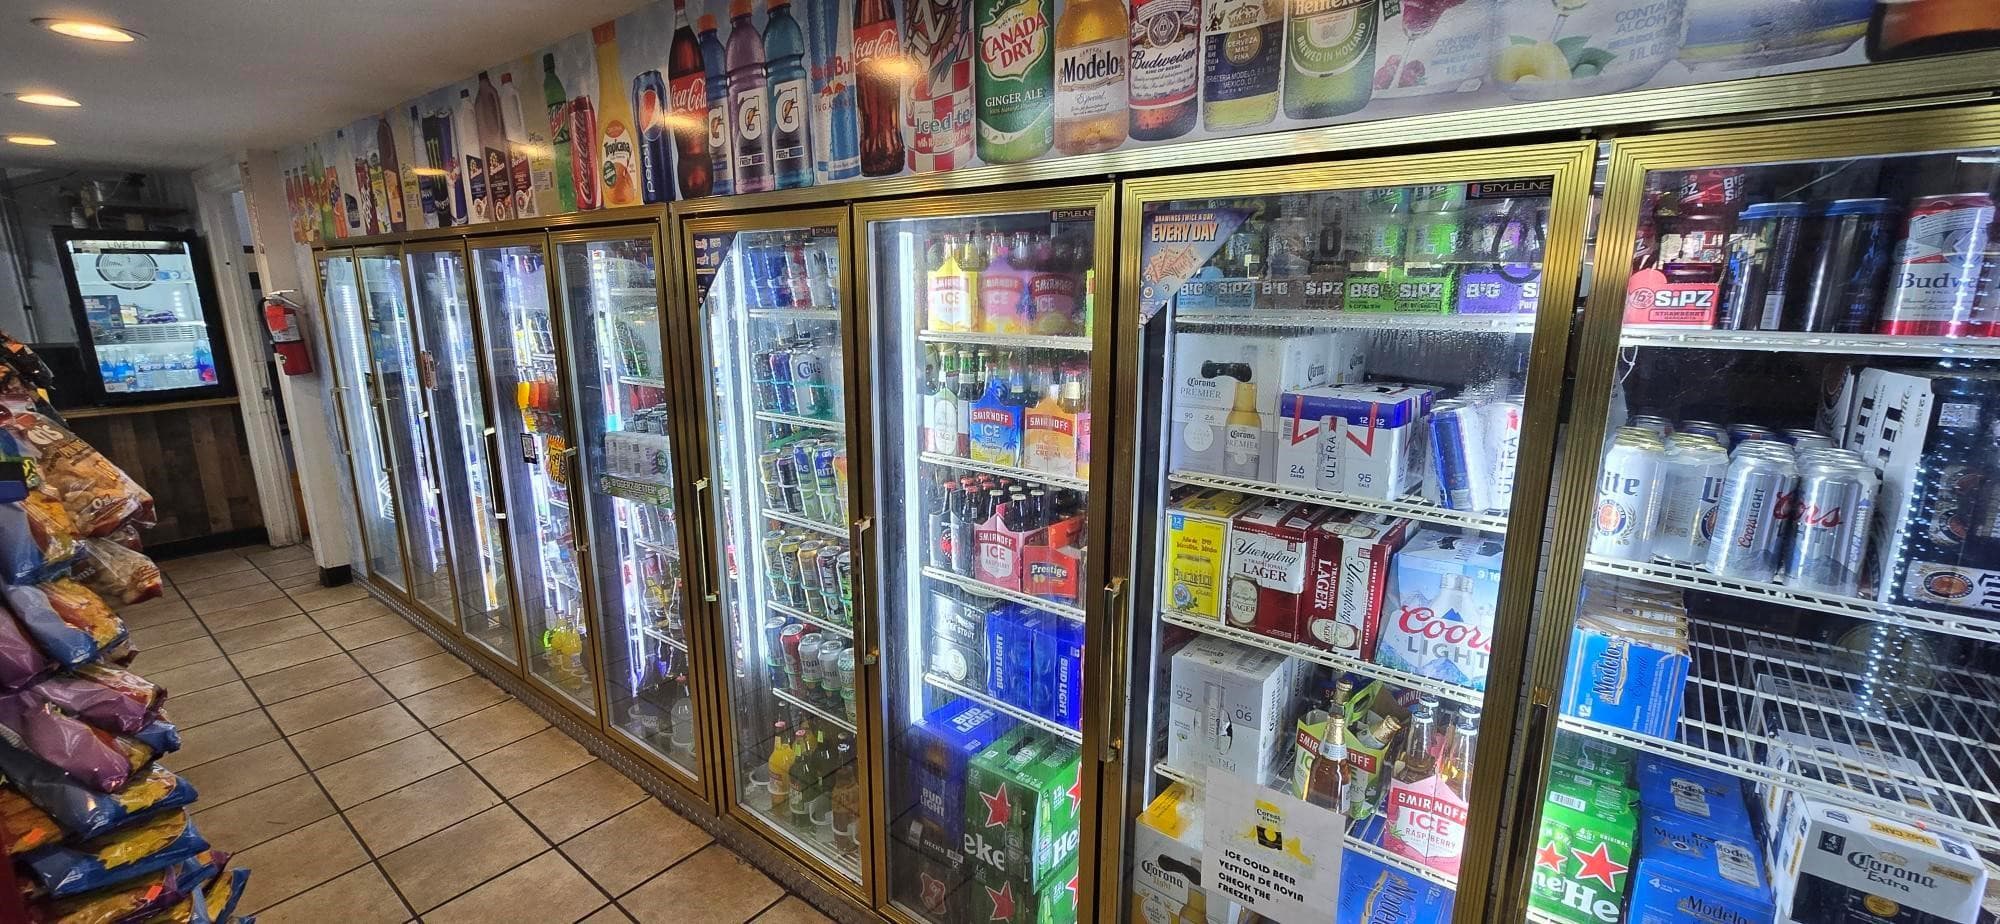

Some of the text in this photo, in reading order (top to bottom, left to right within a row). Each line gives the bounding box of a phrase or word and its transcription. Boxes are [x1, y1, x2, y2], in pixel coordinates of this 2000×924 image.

[980, 11, 1049, 64] CANADA
[1297, 21, 1367, 62] BREWED IN HOLLAND
[1000, 35, 1034, 69] DRY
[1131, 47, 1197, 71] Budweiser
[1063, 50, 1118, 84] Modelo
[775, 87, 799, 133] G
[984, 93, 1022, 109] GINGER
[1023, 88, 1045, 103] ALE
[708, 105, 726, 149] G
[738, 95, 761, 141] G
[1482, 180, 1551, 192] STYLELINE
[1151, 222, 1220, 242] EVERY DAY
[940, 292, 960, 305] ICE
[1653, 309, 1706, 317] STRAWBERRY
[1180, 386, 1222, 400] PREMIER
[1187, 376, 1217, 389] Corona
[972, 410, 1010, 424] SMIRNOFF
[1029, 416, 1069, 432] SMIRNOFF
[980, 425, 1001, 438] ICE
[1230, 428, 1257, 440] Corona
[1225, 438, 1259, 450] PREMIER
[1325, 434, 1338, 479] ULTRA
[1502, 434, 1518, 495] ULTRA
[1290, 463, 1305, 475] 2.6
[1357, 472, 1372, 483] 95
[1749, 487, 1766, 519] LIGHT
[978, 532, 1013, 547] SMIRNOFF
[986, 546, 1006, 561] ICE
[1232, 537, 1299, 567] Yuengling
[1031, 564, 1068, 578] Prestige
[1242, 562, 1288, 583] LAGER
[1314, 558, 1332, 611] LAGER
[1231, 600, 1256, 613] LAGER
[995, 633, 1005, 690] BUD LIGHT
[1407, 635, 1489, 669] LIGHT
[1593, 643, 1623, 700] Modelo
[1057, 657, 1069, 716] BUD LIGHT
[951, 707, 981, 726] BUD
[956, 709, 995, 733] LIGHT
[919, 796, 946, 818] LIGHT
[921, 787, 943, 805] BUD
[1398, 791, 1468, 822] SMIRNOFF
[1408, 813, 1450, 837] ICE
[1404, 826, 1457, 850] RASPBERRY
[1141, 859, 1184, 889] Corona
[1218, 858, 1256, 886] VESTIDA
[1257, 873, 1272, 889] DE
[1225, 849, 1297, 887] ICE COLD BEER
[1847, 851, 1938, 889] Corona
[1217, 871, 1272, 902] CHECK THE
[1217, 881, 1256, 906] FREEZER
[1863, 869, 1911, 894] Extra
